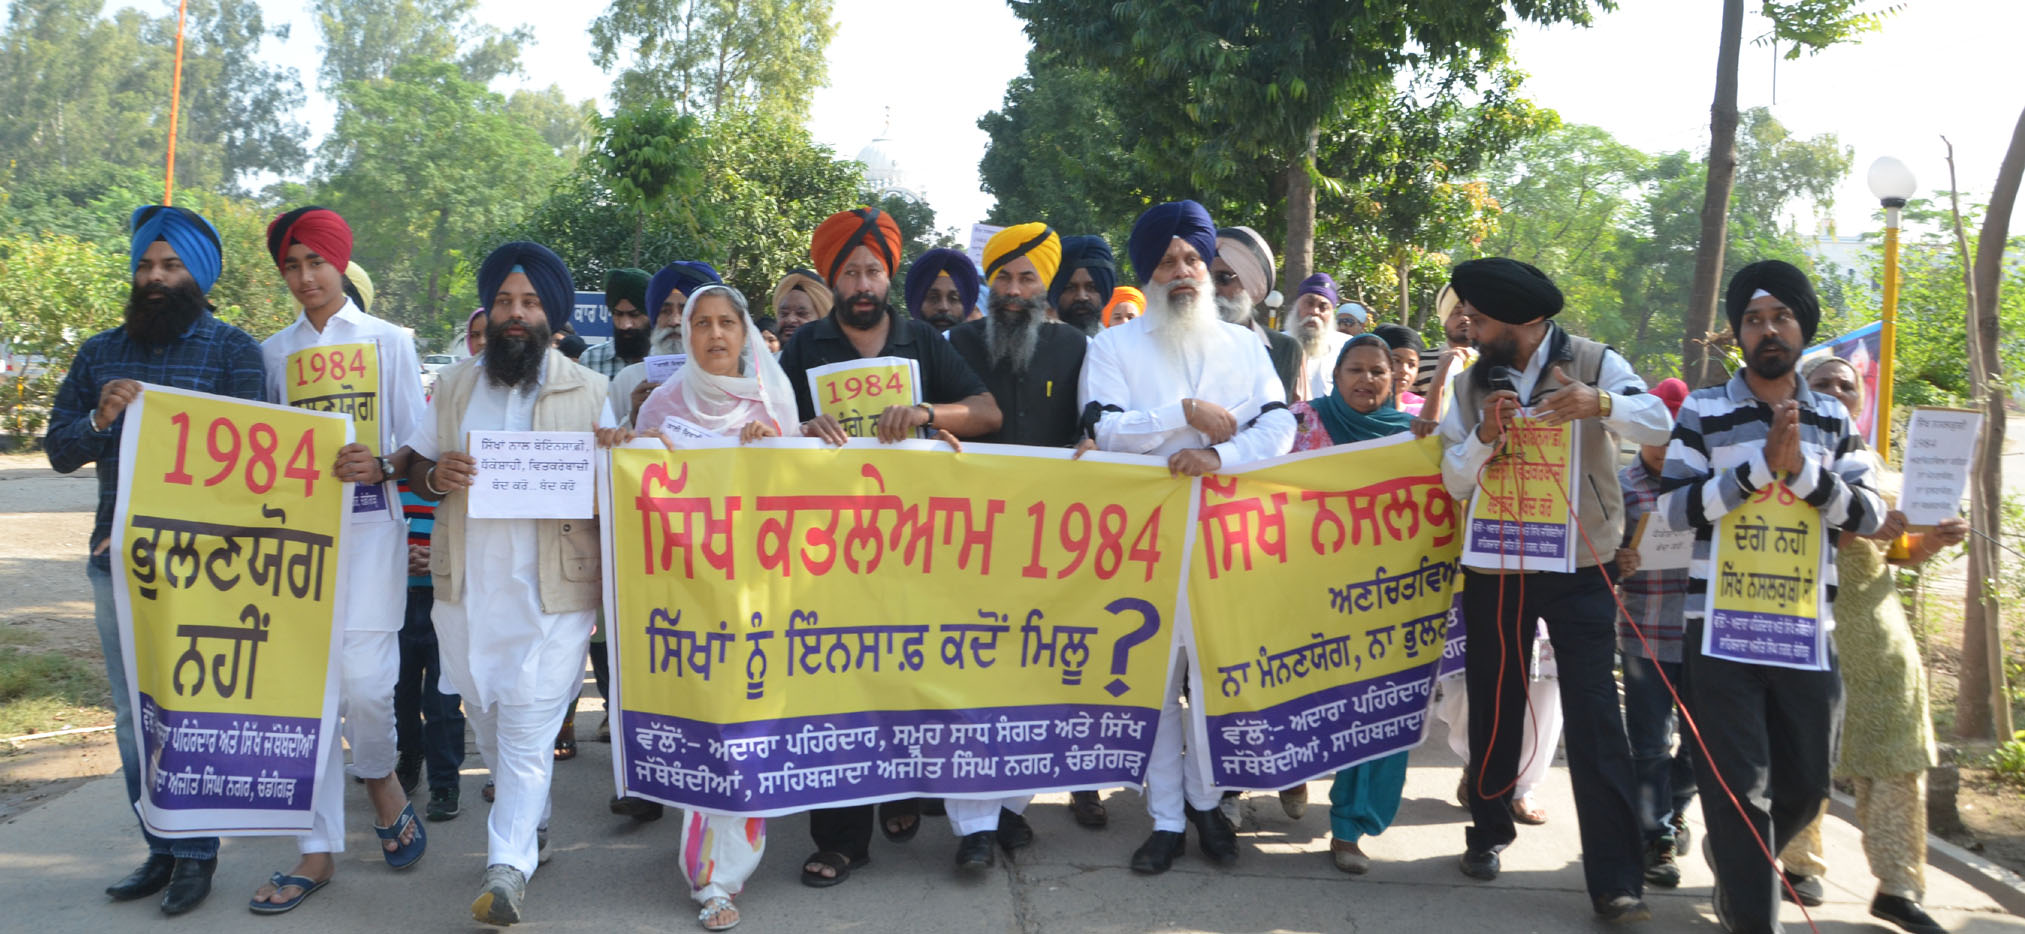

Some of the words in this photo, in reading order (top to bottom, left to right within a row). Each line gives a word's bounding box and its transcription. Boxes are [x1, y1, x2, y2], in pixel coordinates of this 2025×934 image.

[295, 349, 366, 387] 1984
[826, 372, 904, 405] 1984
[164, 411, 320, 498] 1984
[635, 461, 742, 580] ਸਿੱਖ
[756, 463, 1006, 577] ਕਤਲੇਆਮ
[1022, 500, 1163, 583] 1984
[1197, 473, 1288, 579] ਸਿੱਖ
[1301, 472, 1456, 556] ਨਸਲਕੁ
[1733, 515, 1769, 552] ਦੰਗੇ
[1774, 521, 1809, 556] ਨਹੀਂ
[131, 503, 334, 602] ਭੁਲਣਯੋਗ
[1721, 561, 1745, 598] ਸਿੱਖ
[173, 603, 271, 700] ਨਹੀਂ
[645, 608, 736, 681] ਸਿੱਖਾਂ
[745, 611, 774, 700] ਨੂੰ
[940, 608, 1011, 670] ਕਦੋਂ
[1217, 662, 1250, 698] ਨਾ
[1366, 625, 1396, 660] ਨਾ
[240, 721, 264, 756] ਸਿੱਖ
[708, 734, 780, 762] ਅਦਾਰਾ
[786, 723, 887, 755] ਪਹਿਰੇਦਾਰ,
[950, 723, 991, 746] ਸਾਧ
[996, 715, 1050, 743] ਸੰਗਤ
[1055, 711, 1094, 739] ਅਤੇ
[1099, 712, 1146, 740] ਸਿੱਖ
[1289, 699, 1347, 732] ਅਦਾਰਾ
[168, 765, 202, 796] ਅਜੀਤ
[202, 765, 226, 797] ਸਿੰਘ
[758, 762, 871, 795] ਸਾਹਿਬਜ਼ਾਦਾ
[877, 751, 946, 780] ਅਜੀਤ
[951, 749, 999, 779] ਸਿੰਘ
[1004, 753, 1060, 778] ਨਗਰ,
